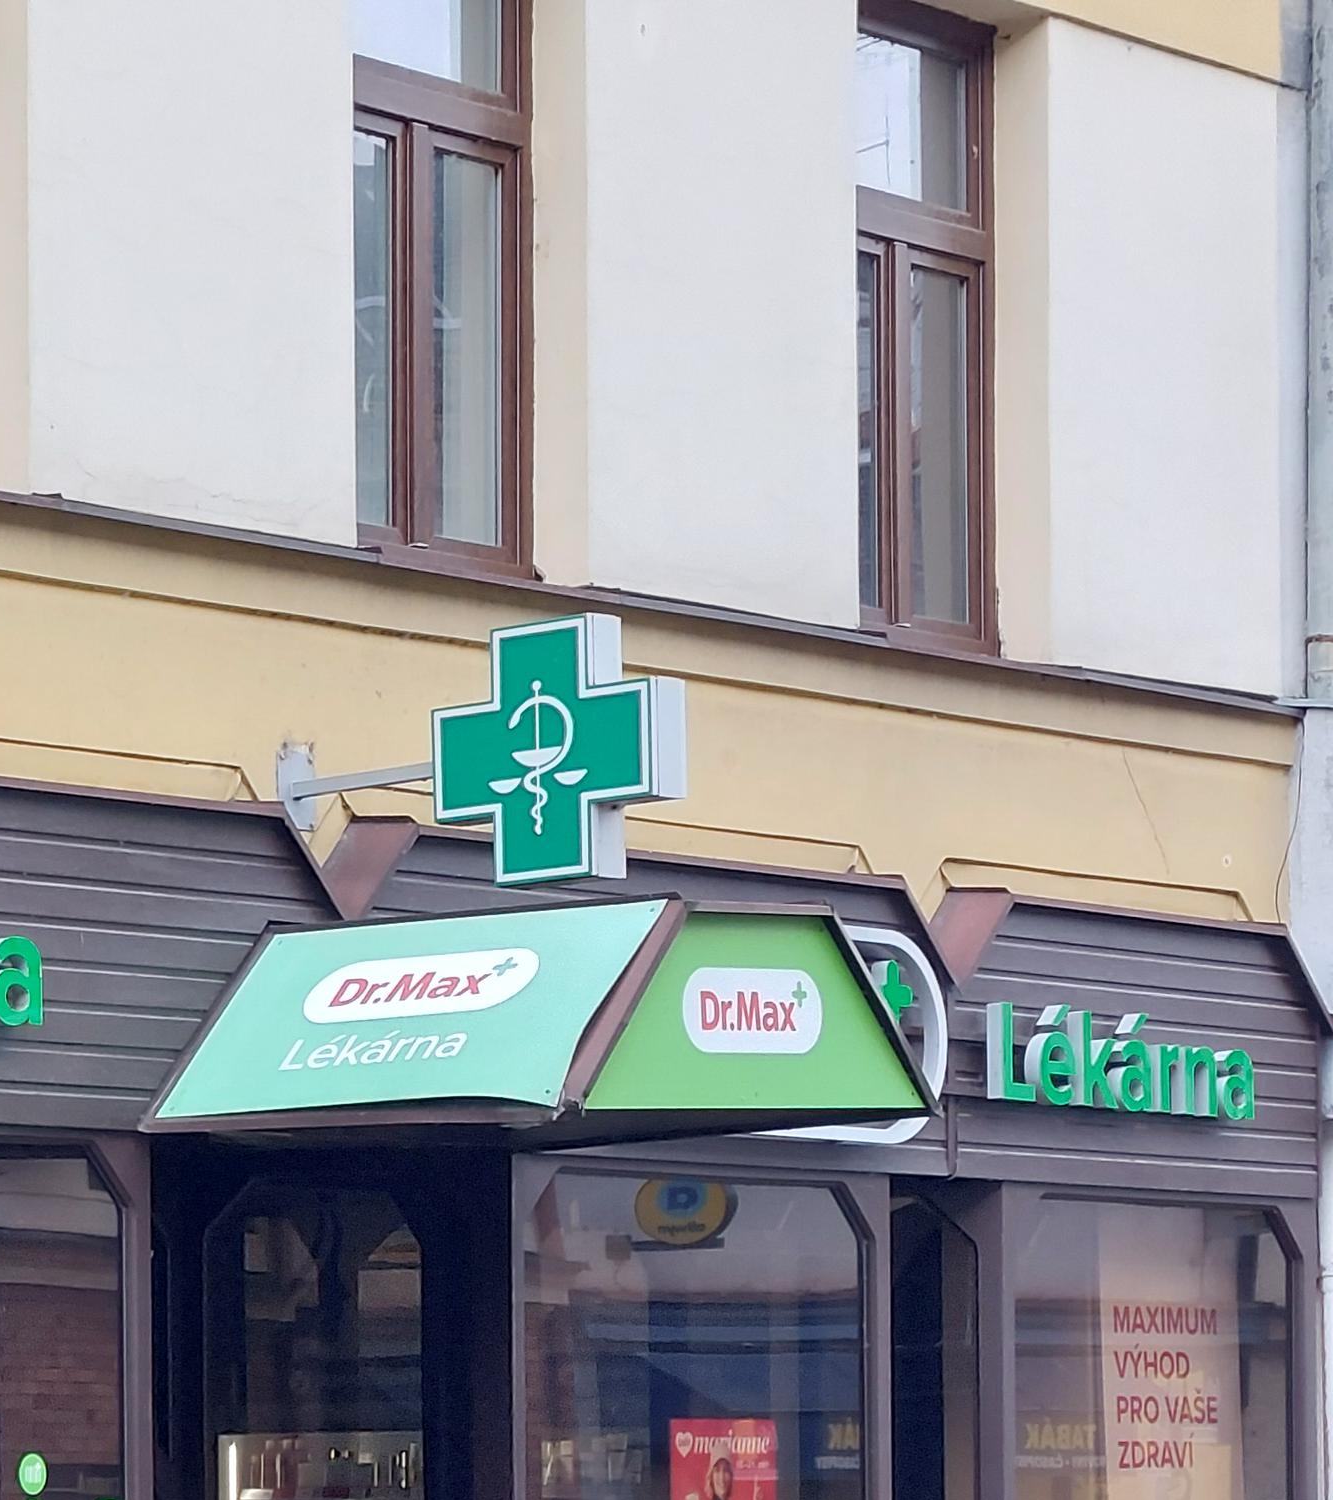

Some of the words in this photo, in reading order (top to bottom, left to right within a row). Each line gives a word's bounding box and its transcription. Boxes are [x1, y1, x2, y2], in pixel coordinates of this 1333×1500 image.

[328, 972, 493, 1008] Dr.Max
[699, 990, 797, 1032] Dr.Max
[277, 1030, 469, 1071] Lékárna
[986, 1001, 1255, 1120] Lékárna
[1113, 1305, 1217, 1335] MAXIMUM
[1114, 1343, 1190, 1379] VÝHOD
[1116, 1395, 1159, 1424] PRO
[1165, 1387, 1218, 1424] VAŠE
[1118, 1432, 1195, 1469] ZDRAVÍ
